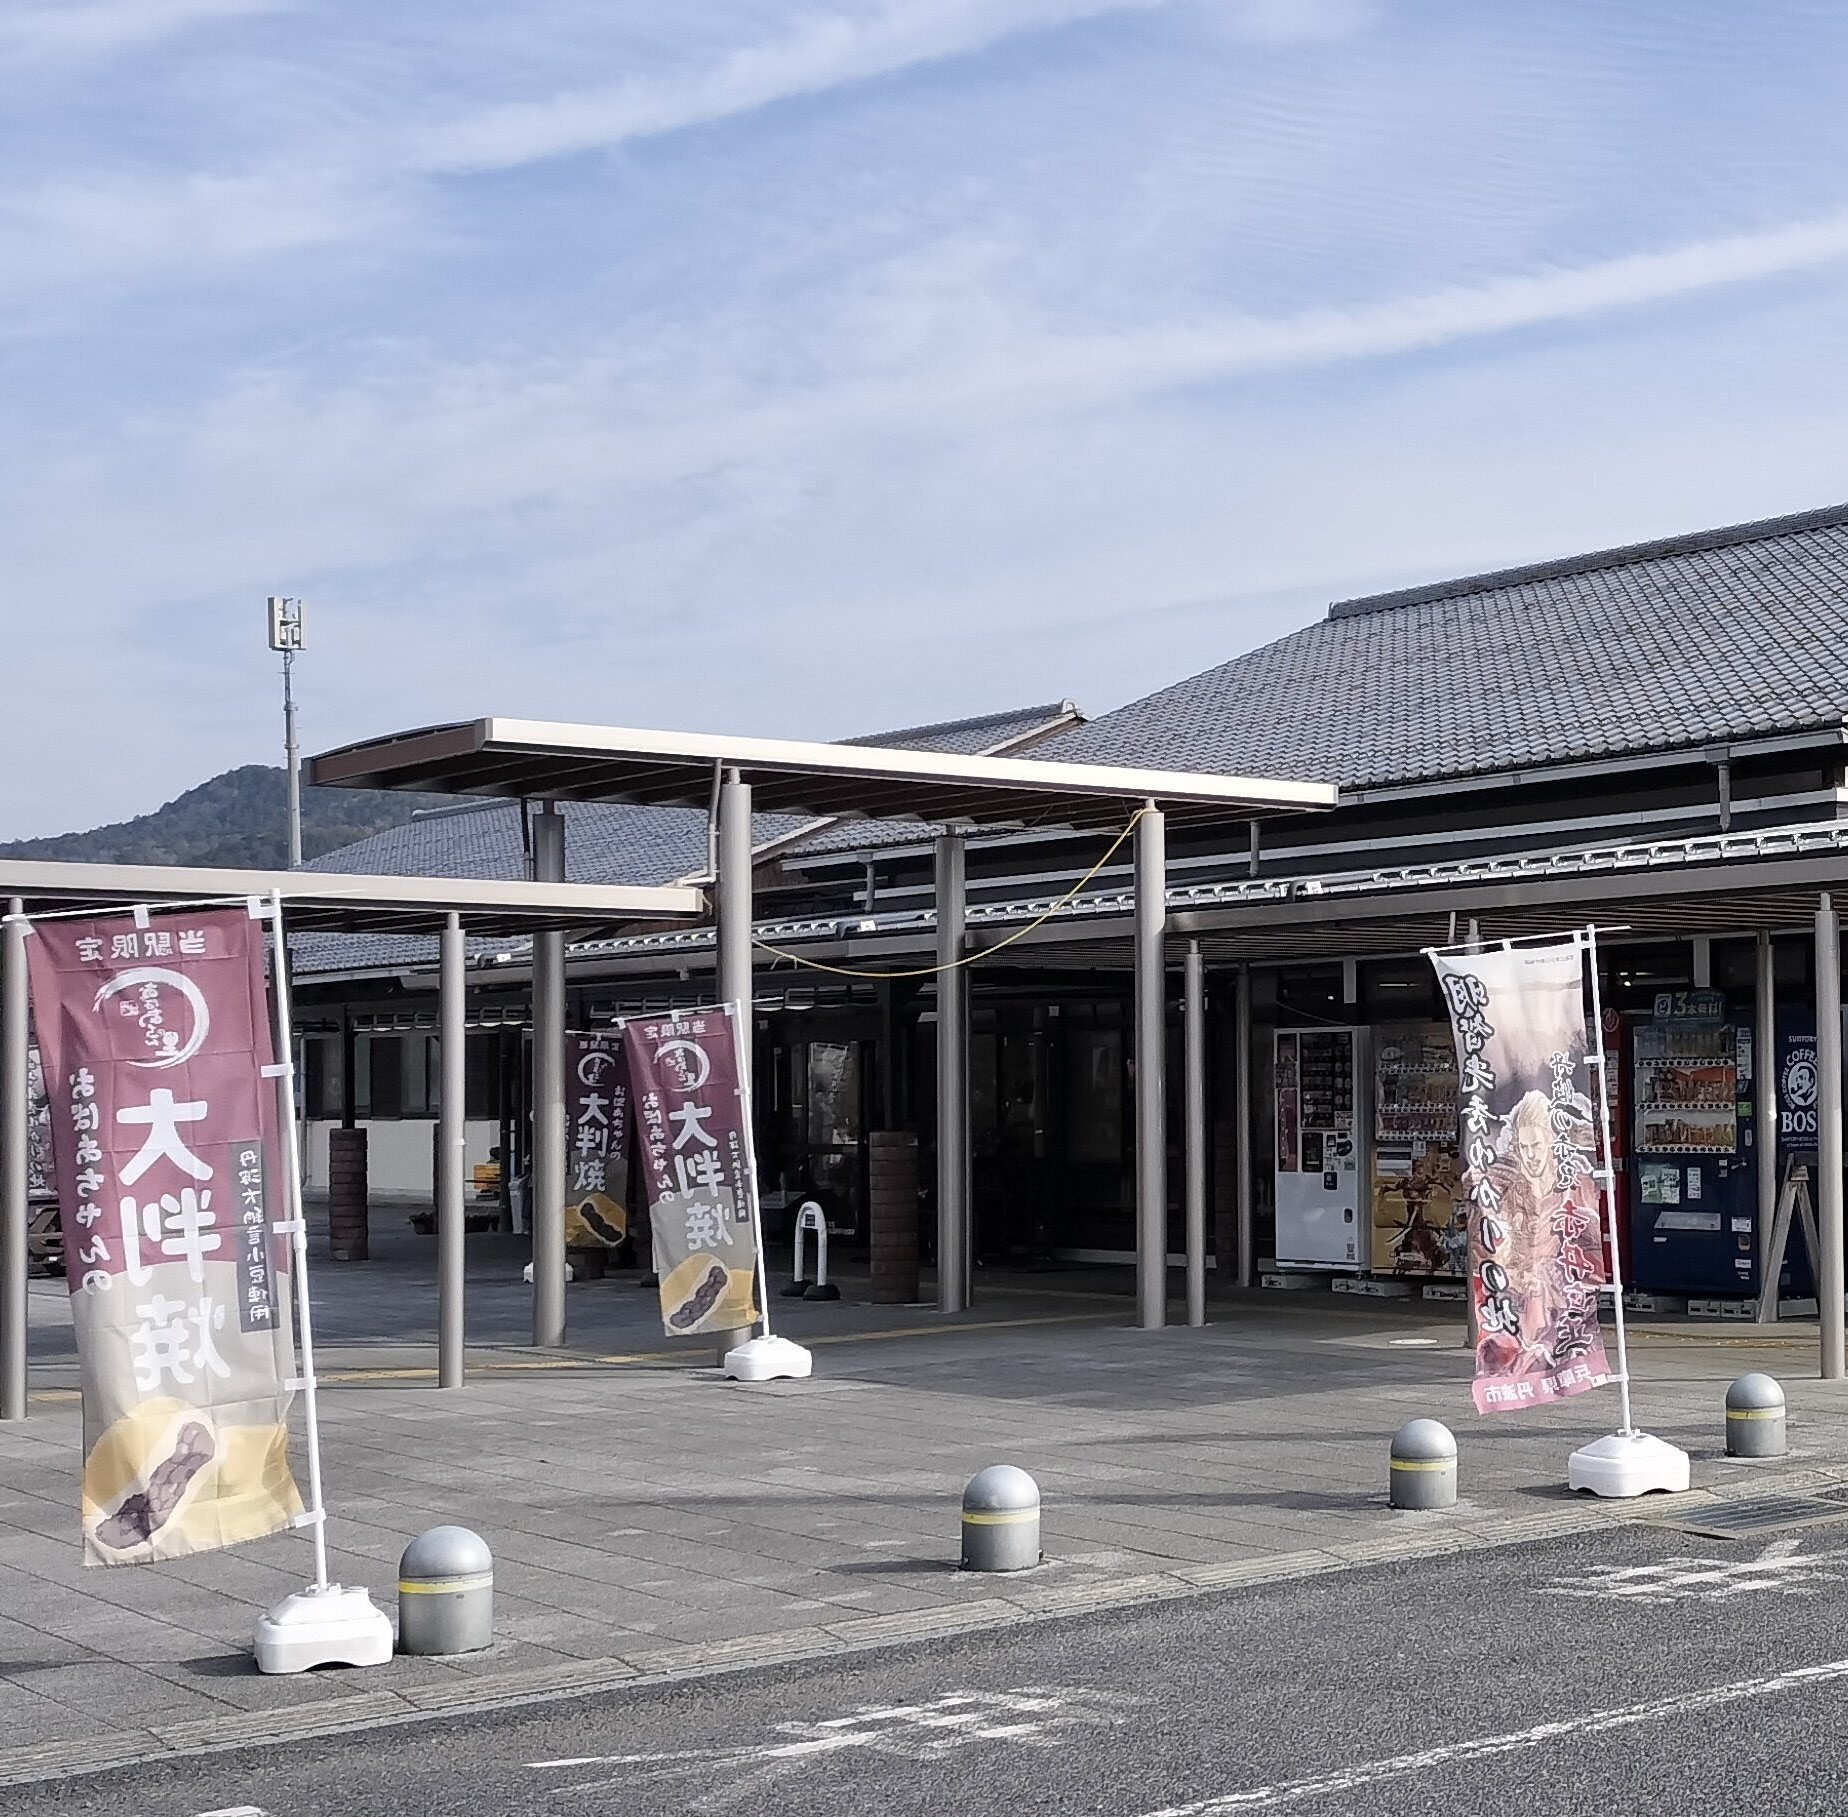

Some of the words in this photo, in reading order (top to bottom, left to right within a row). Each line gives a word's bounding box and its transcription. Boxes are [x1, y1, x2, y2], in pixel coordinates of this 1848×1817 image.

[573, 1092, 609, 1192] 大判焼
[1781, 1110, 1818, 1133] BOS
